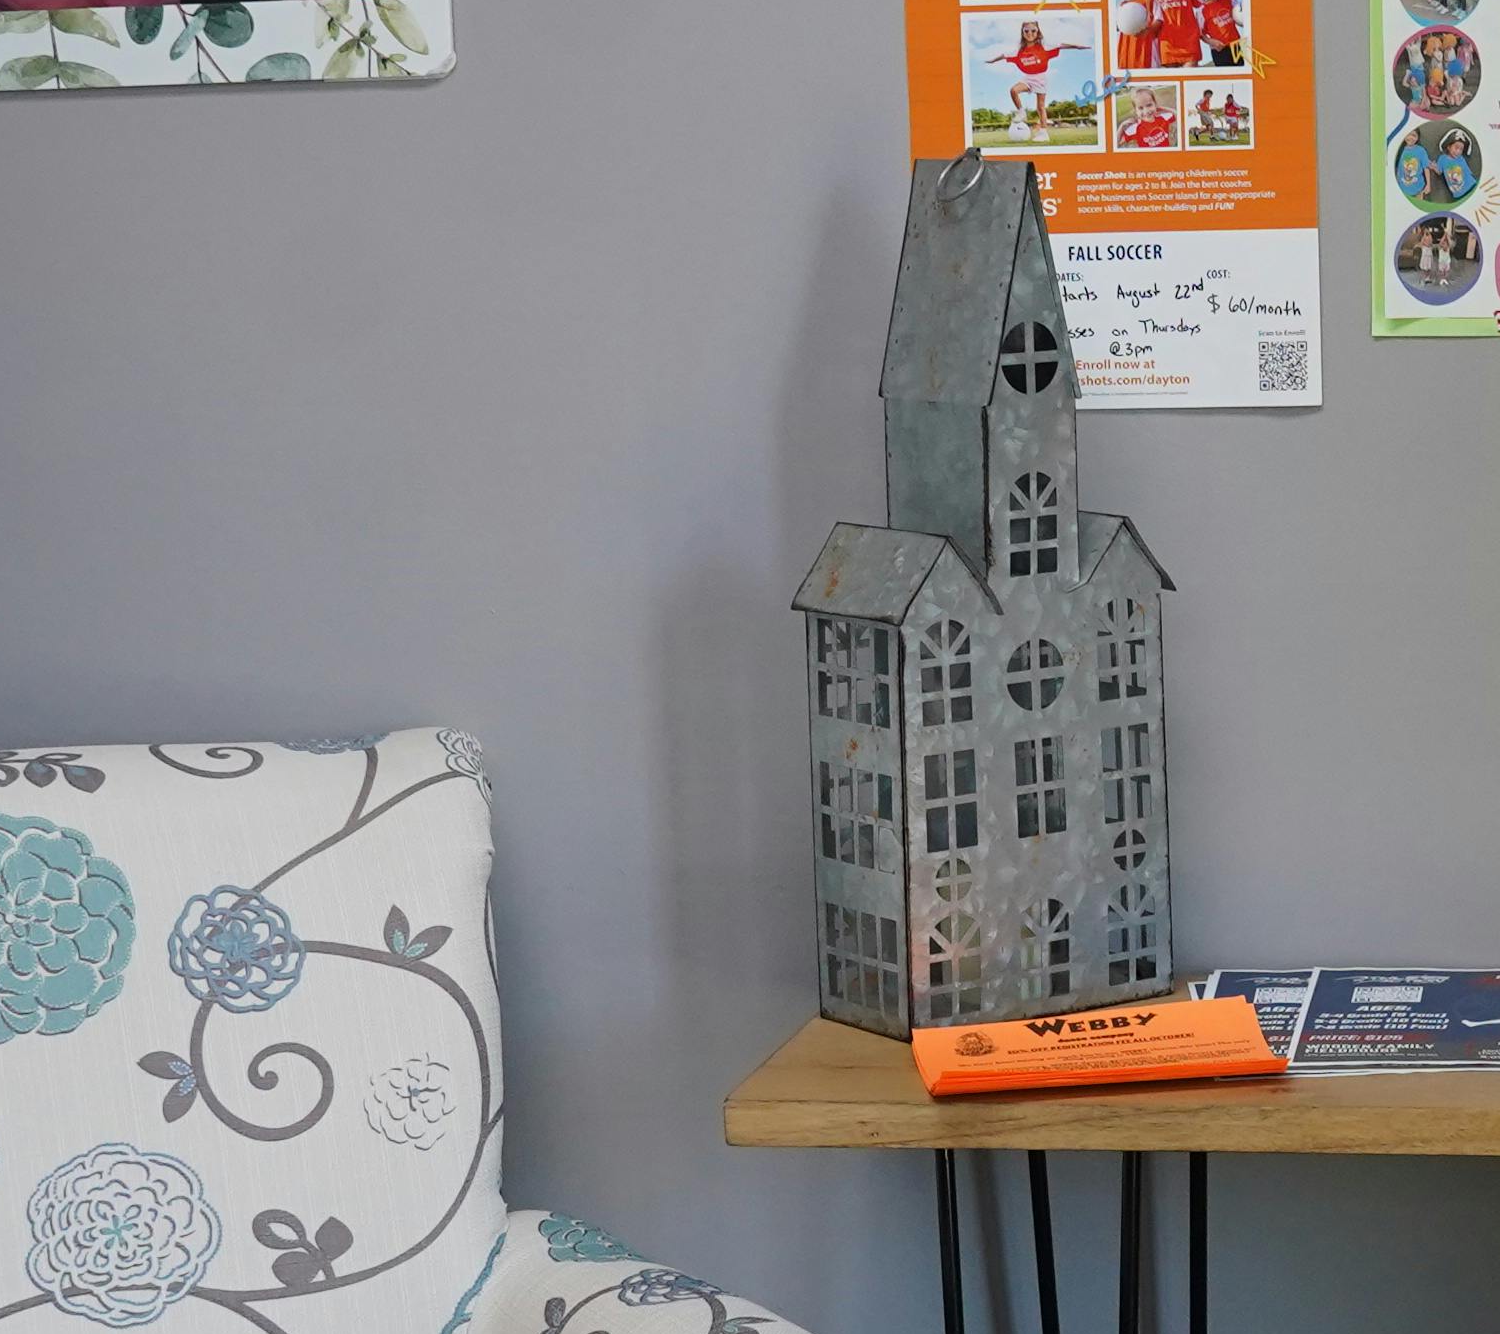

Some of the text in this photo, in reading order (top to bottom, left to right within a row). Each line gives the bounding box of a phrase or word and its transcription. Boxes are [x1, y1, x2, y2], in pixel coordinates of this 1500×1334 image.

[1068, 244, 1163, 262] FALL SOCCER
[1206, 269, 1231, 279] COST:
[1116, 278, 1204, 308] August 22nd
[1207, 294, 1303, 317] $ 60/month
[1111, 318, 1202, 337] on Thursdays
[1075, 360, 1156, 371] Enroll now at
[1025, 1012, 1159, 1037] WEBBY
